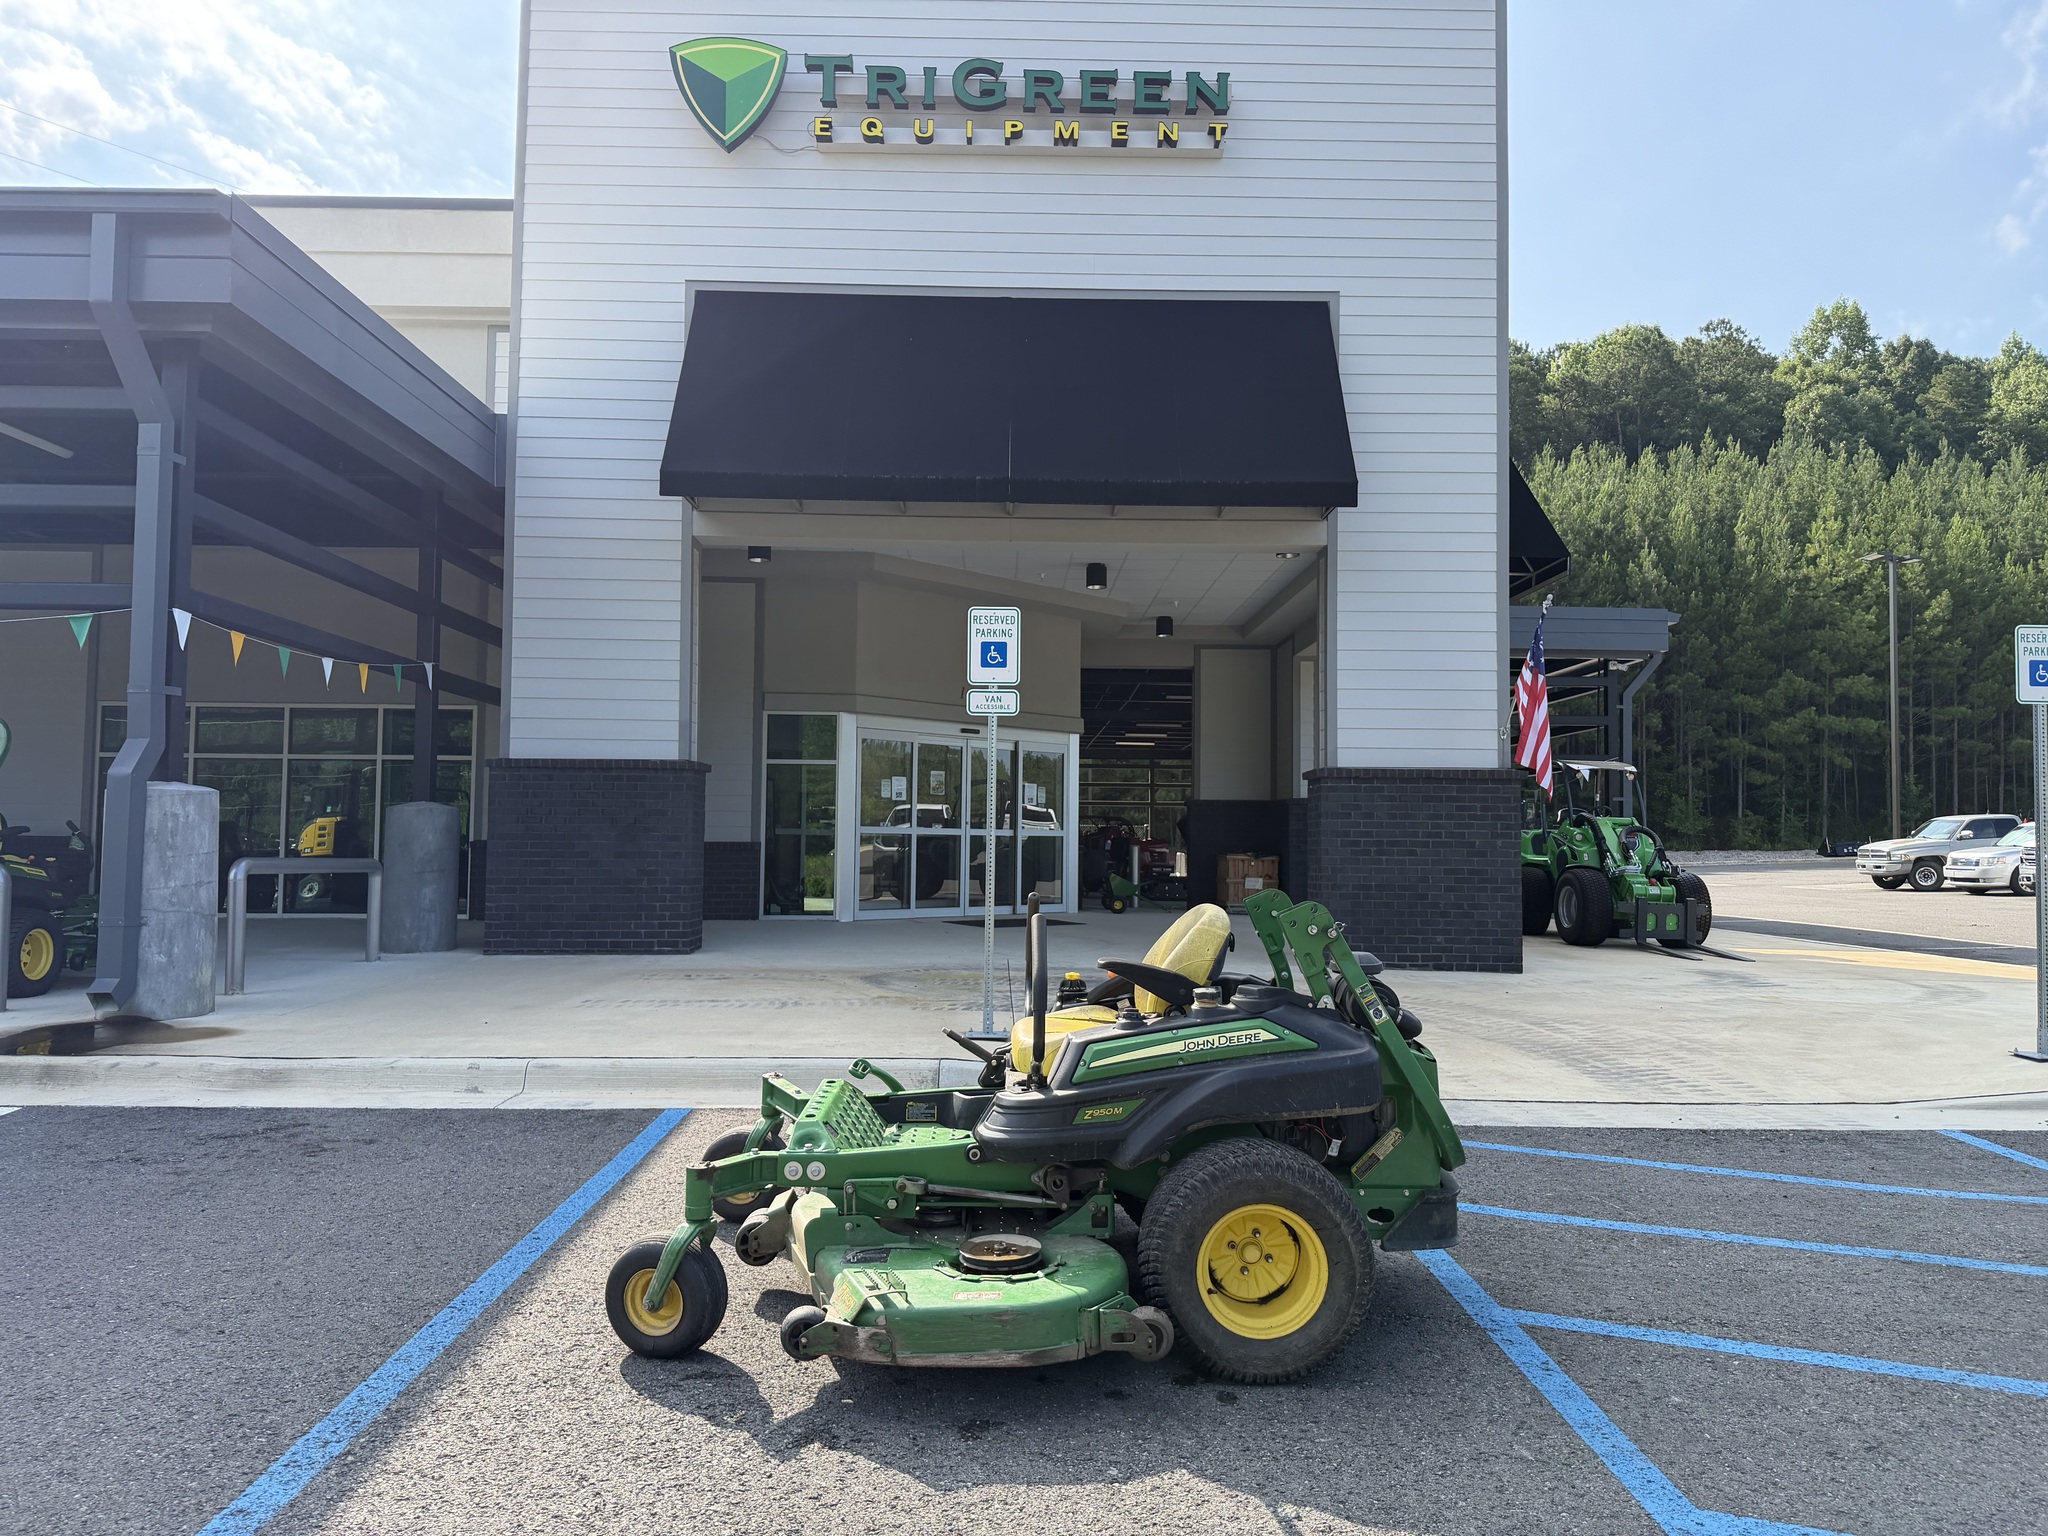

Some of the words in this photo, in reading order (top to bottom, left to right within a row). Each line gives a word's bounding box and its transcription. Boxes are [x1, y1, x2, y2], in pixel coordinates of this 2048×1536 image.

[814, 116, 1228, 149] EQUIPMENT
[973, 615, 1016, 625] RESERVED
[975, 628, 1013, 638] PARKING
[984, 695, 1002, 703] VAN
[1180, 1038, 1215, 1052] JOHN
[1218, 1033, 1262, 1046] DEERE
[1083, 1106, 1124, 1120] Z950M
